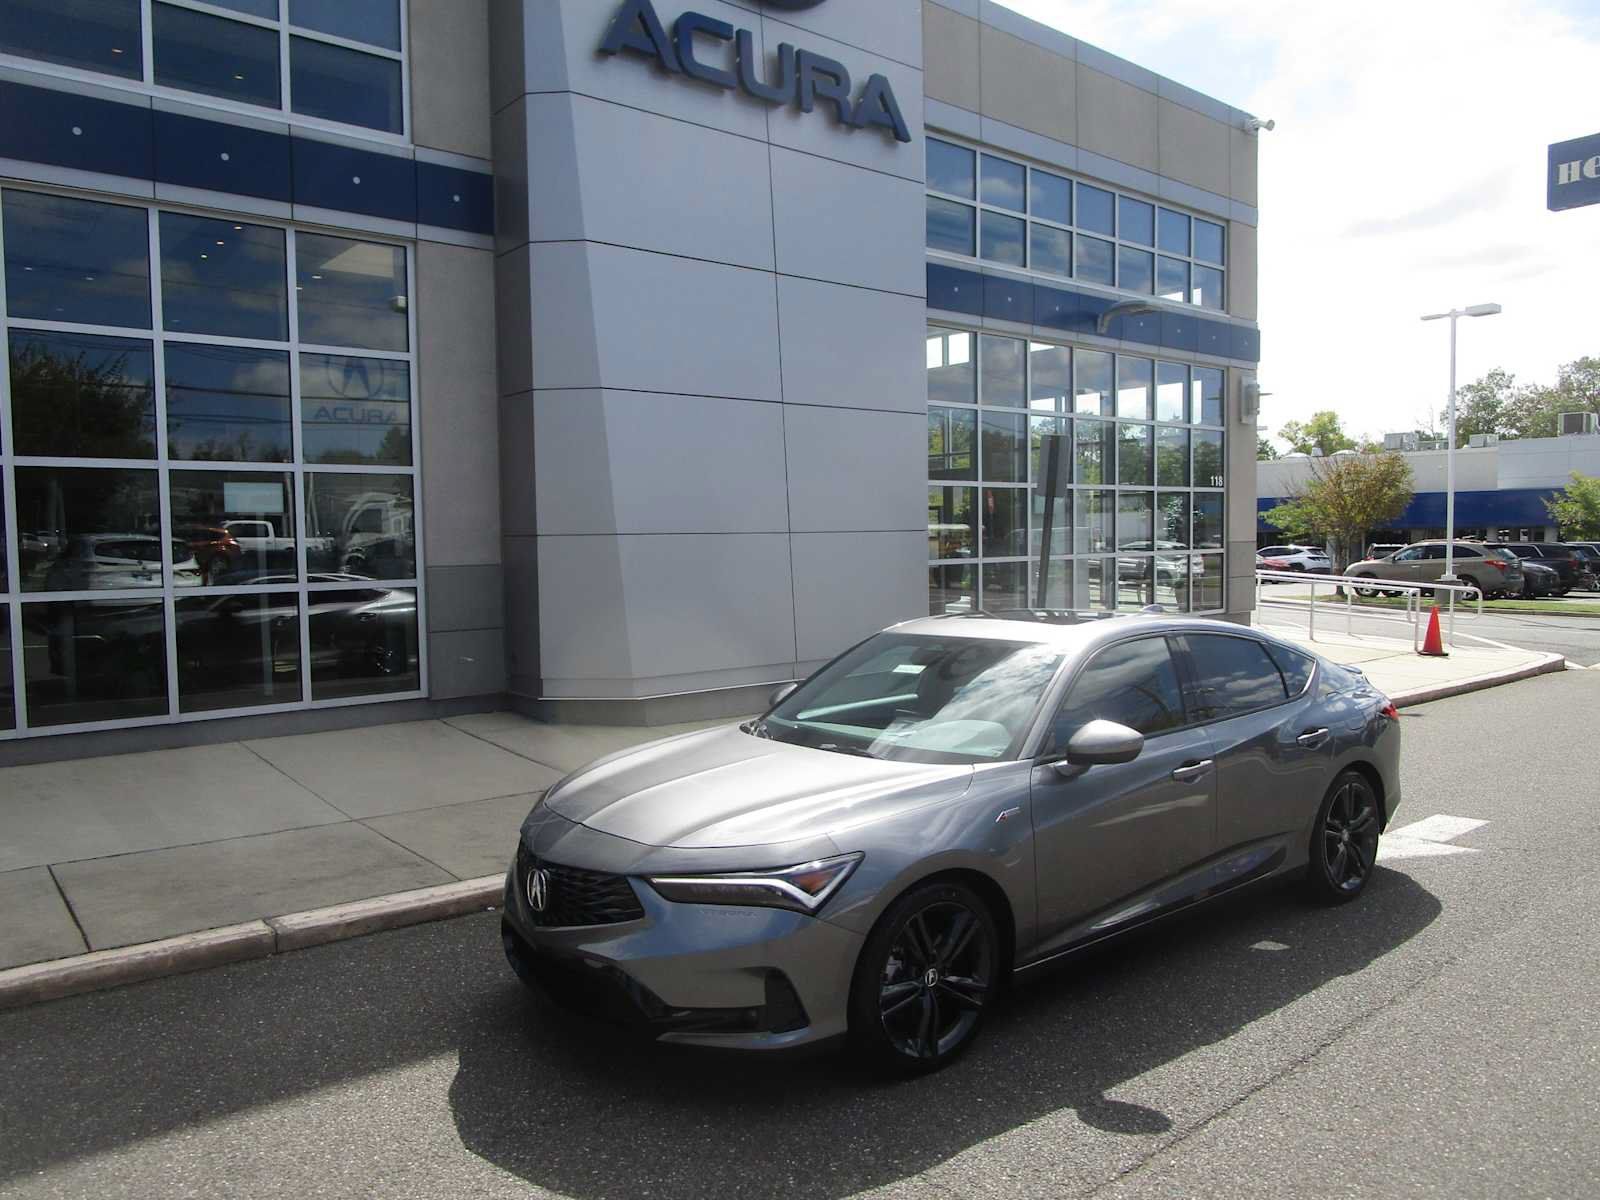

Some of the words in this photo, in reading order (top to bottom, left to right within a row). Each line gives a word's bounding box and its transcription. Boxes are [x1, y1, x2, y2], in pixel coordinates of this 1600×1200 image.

[600, 0, 911, 143] ACURA
[314, 405, 398, 424] ACURA
[1210, 475, 1223, 487] 118
